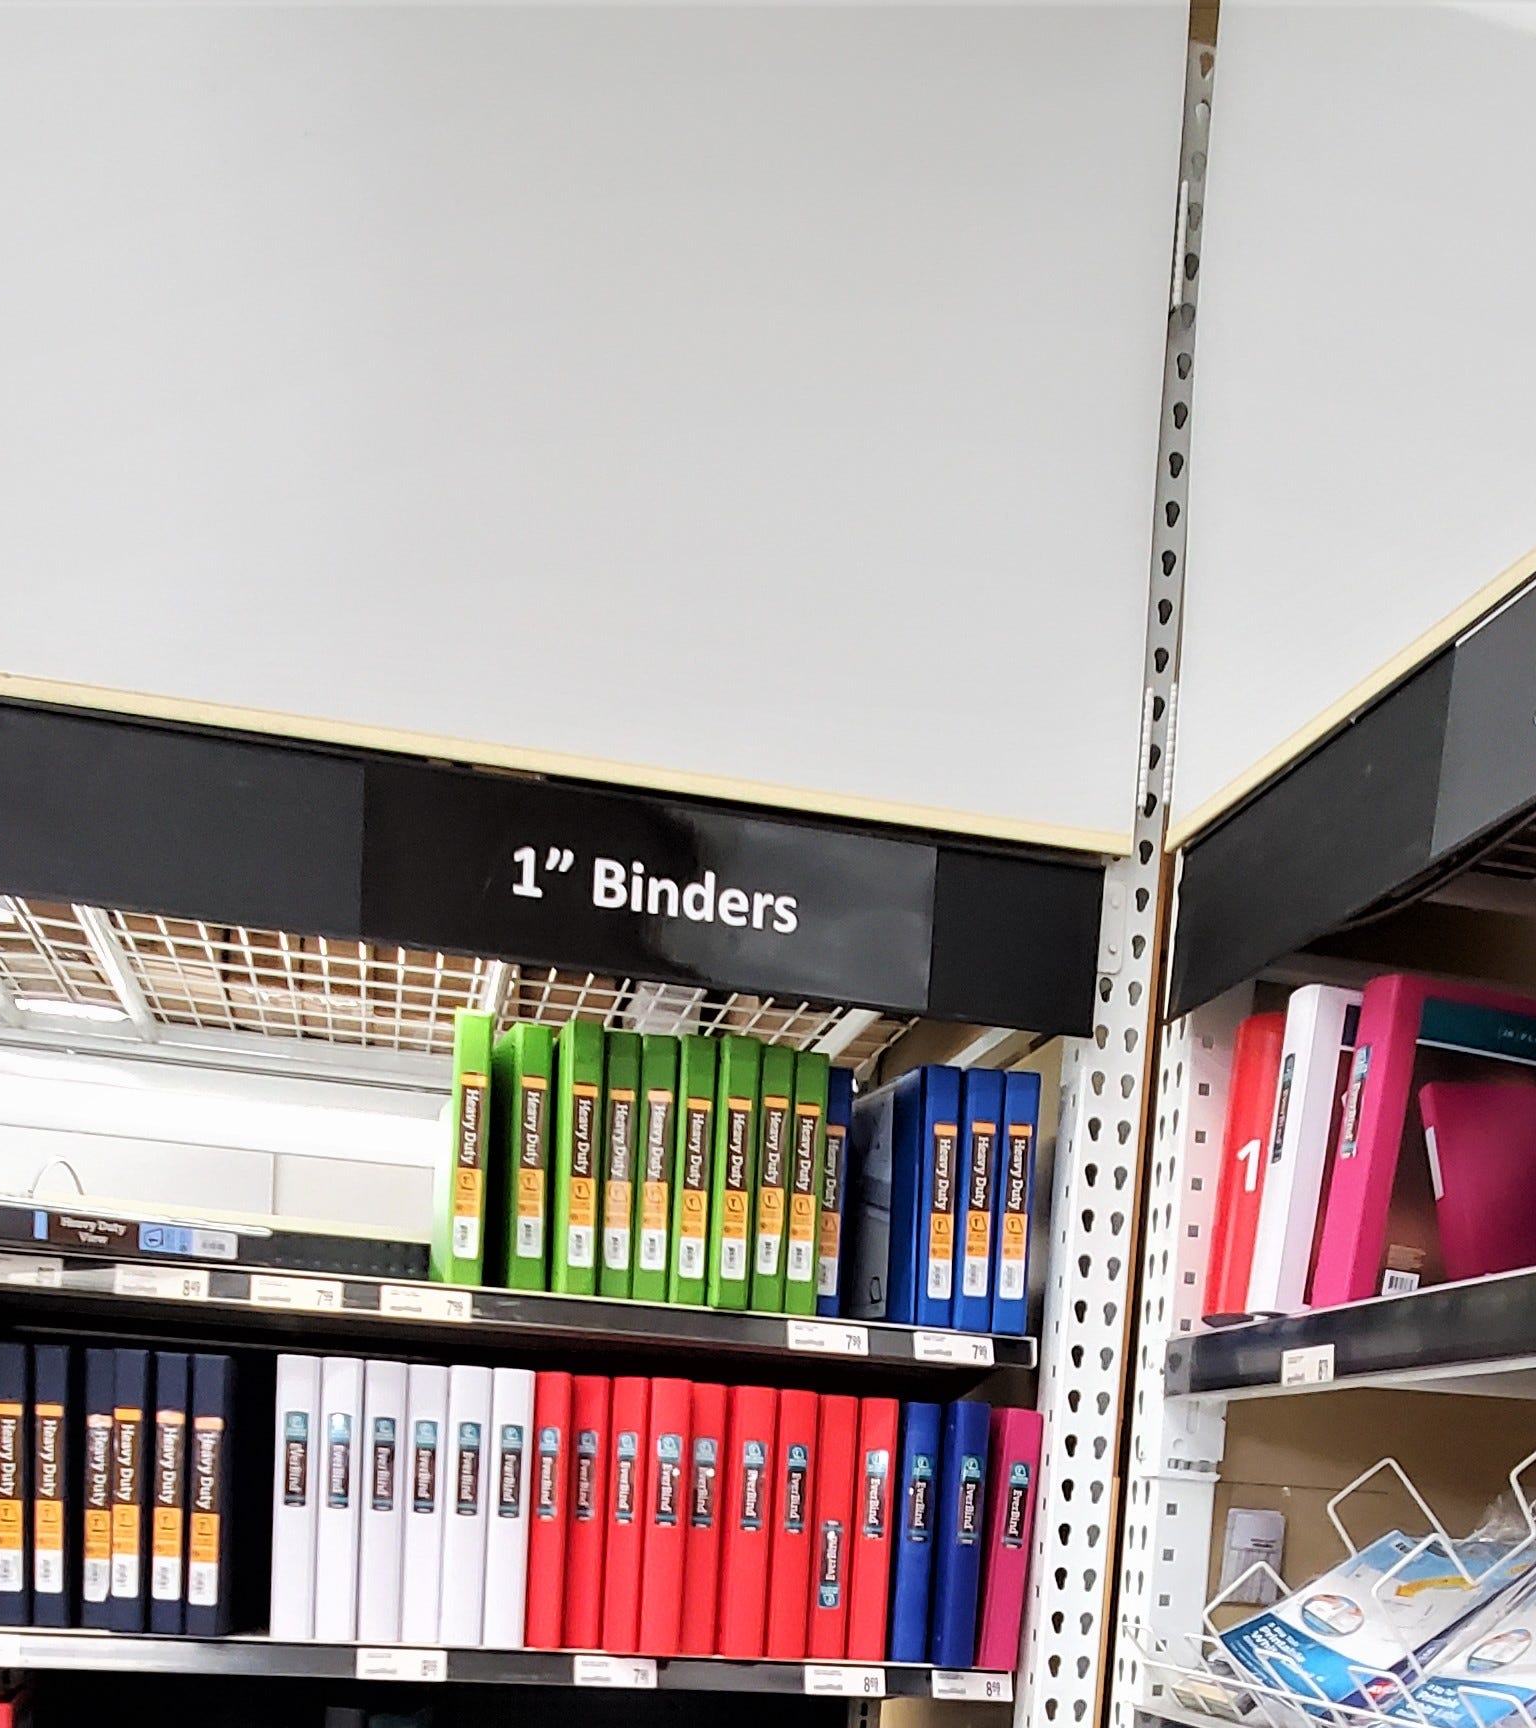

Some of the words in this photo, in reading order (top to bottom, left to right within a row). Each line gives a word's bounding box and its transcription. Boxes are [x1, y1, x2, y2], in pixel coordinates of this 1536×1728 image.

[593, 858, 798, 934] Binders
[462, 1088, 480, 1131] Heavy
[523, 1091, 540, 1132] Heavy
[575, 1099, 591, 1143] Heavy
[461, 1133, 476, 1165] Duty
[522, 1134, 539, 1165] Duty
[689, 1112, 704, 1153] Heavy
[730, 1113, 745, 1154] Heavy
[766, 1111, 782, 1151] Heavy
[798, 1118, 813, 1158] Heavy
[574, 1143, 590, 1174] Duty
[687, 1155, 702, 1187] Duty
[729, 1155, 744, 1188] Duty
[764, 1152, 780, 1184] Duty
[796, 1160, 811, 1191] Duty
[936, 1139, 951, 1178] Heavy
[973, 1136, 990, 1176] Heavy
[934, 1179, 949, 1210] Duty
[972, 1178, 987, 1208] Duty
[744, 1468, 759, 1518] EverBind
[868, 1477, 881, 1526] EverBind
[914, 1481, 927, 1528] EverBind
[965, 1482, 977, 1530] EverBind
[1009, 1488, 1023, 1537] EverBind
